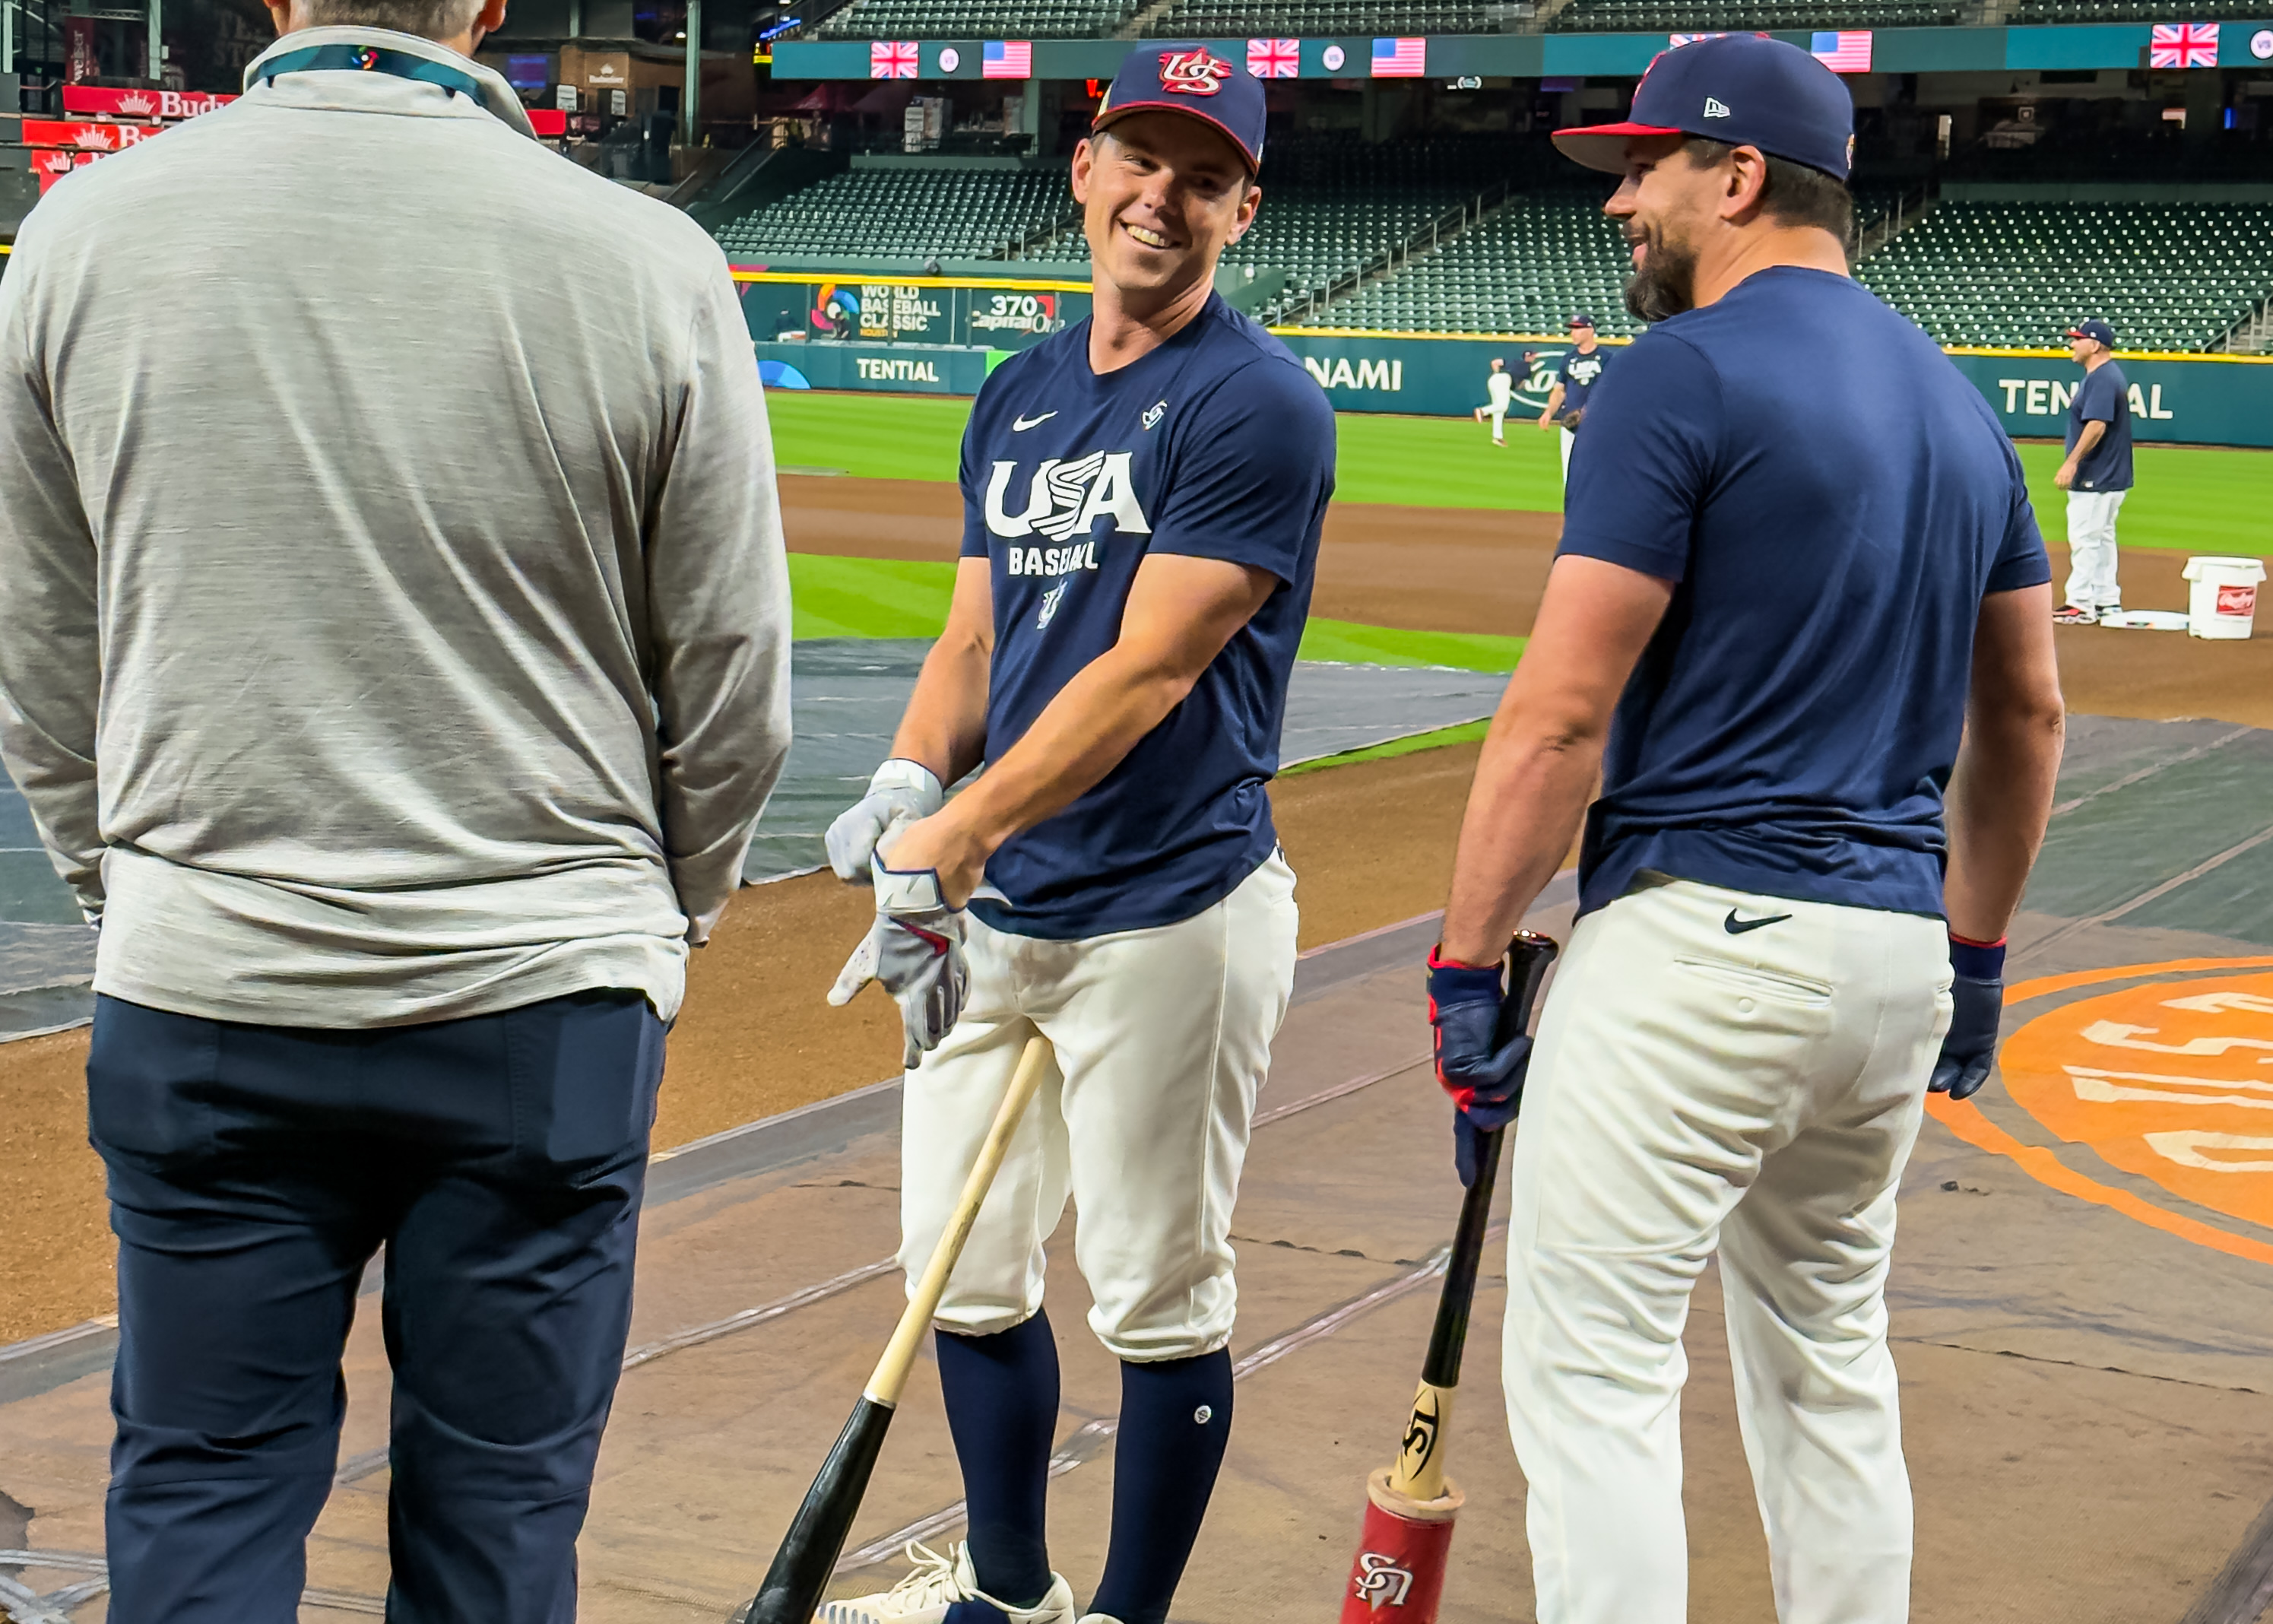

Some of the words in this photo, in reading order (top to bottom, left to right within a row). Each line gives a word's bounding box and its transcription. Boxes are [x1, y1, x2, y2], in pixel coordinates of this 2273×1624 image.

[991, 295, 1038, 316] 370
[860, 328, 899, 338] HOUSTN
[856, 358, 939, 382] TENTIAL
[1998, 379, 2174, 420] TENAL
